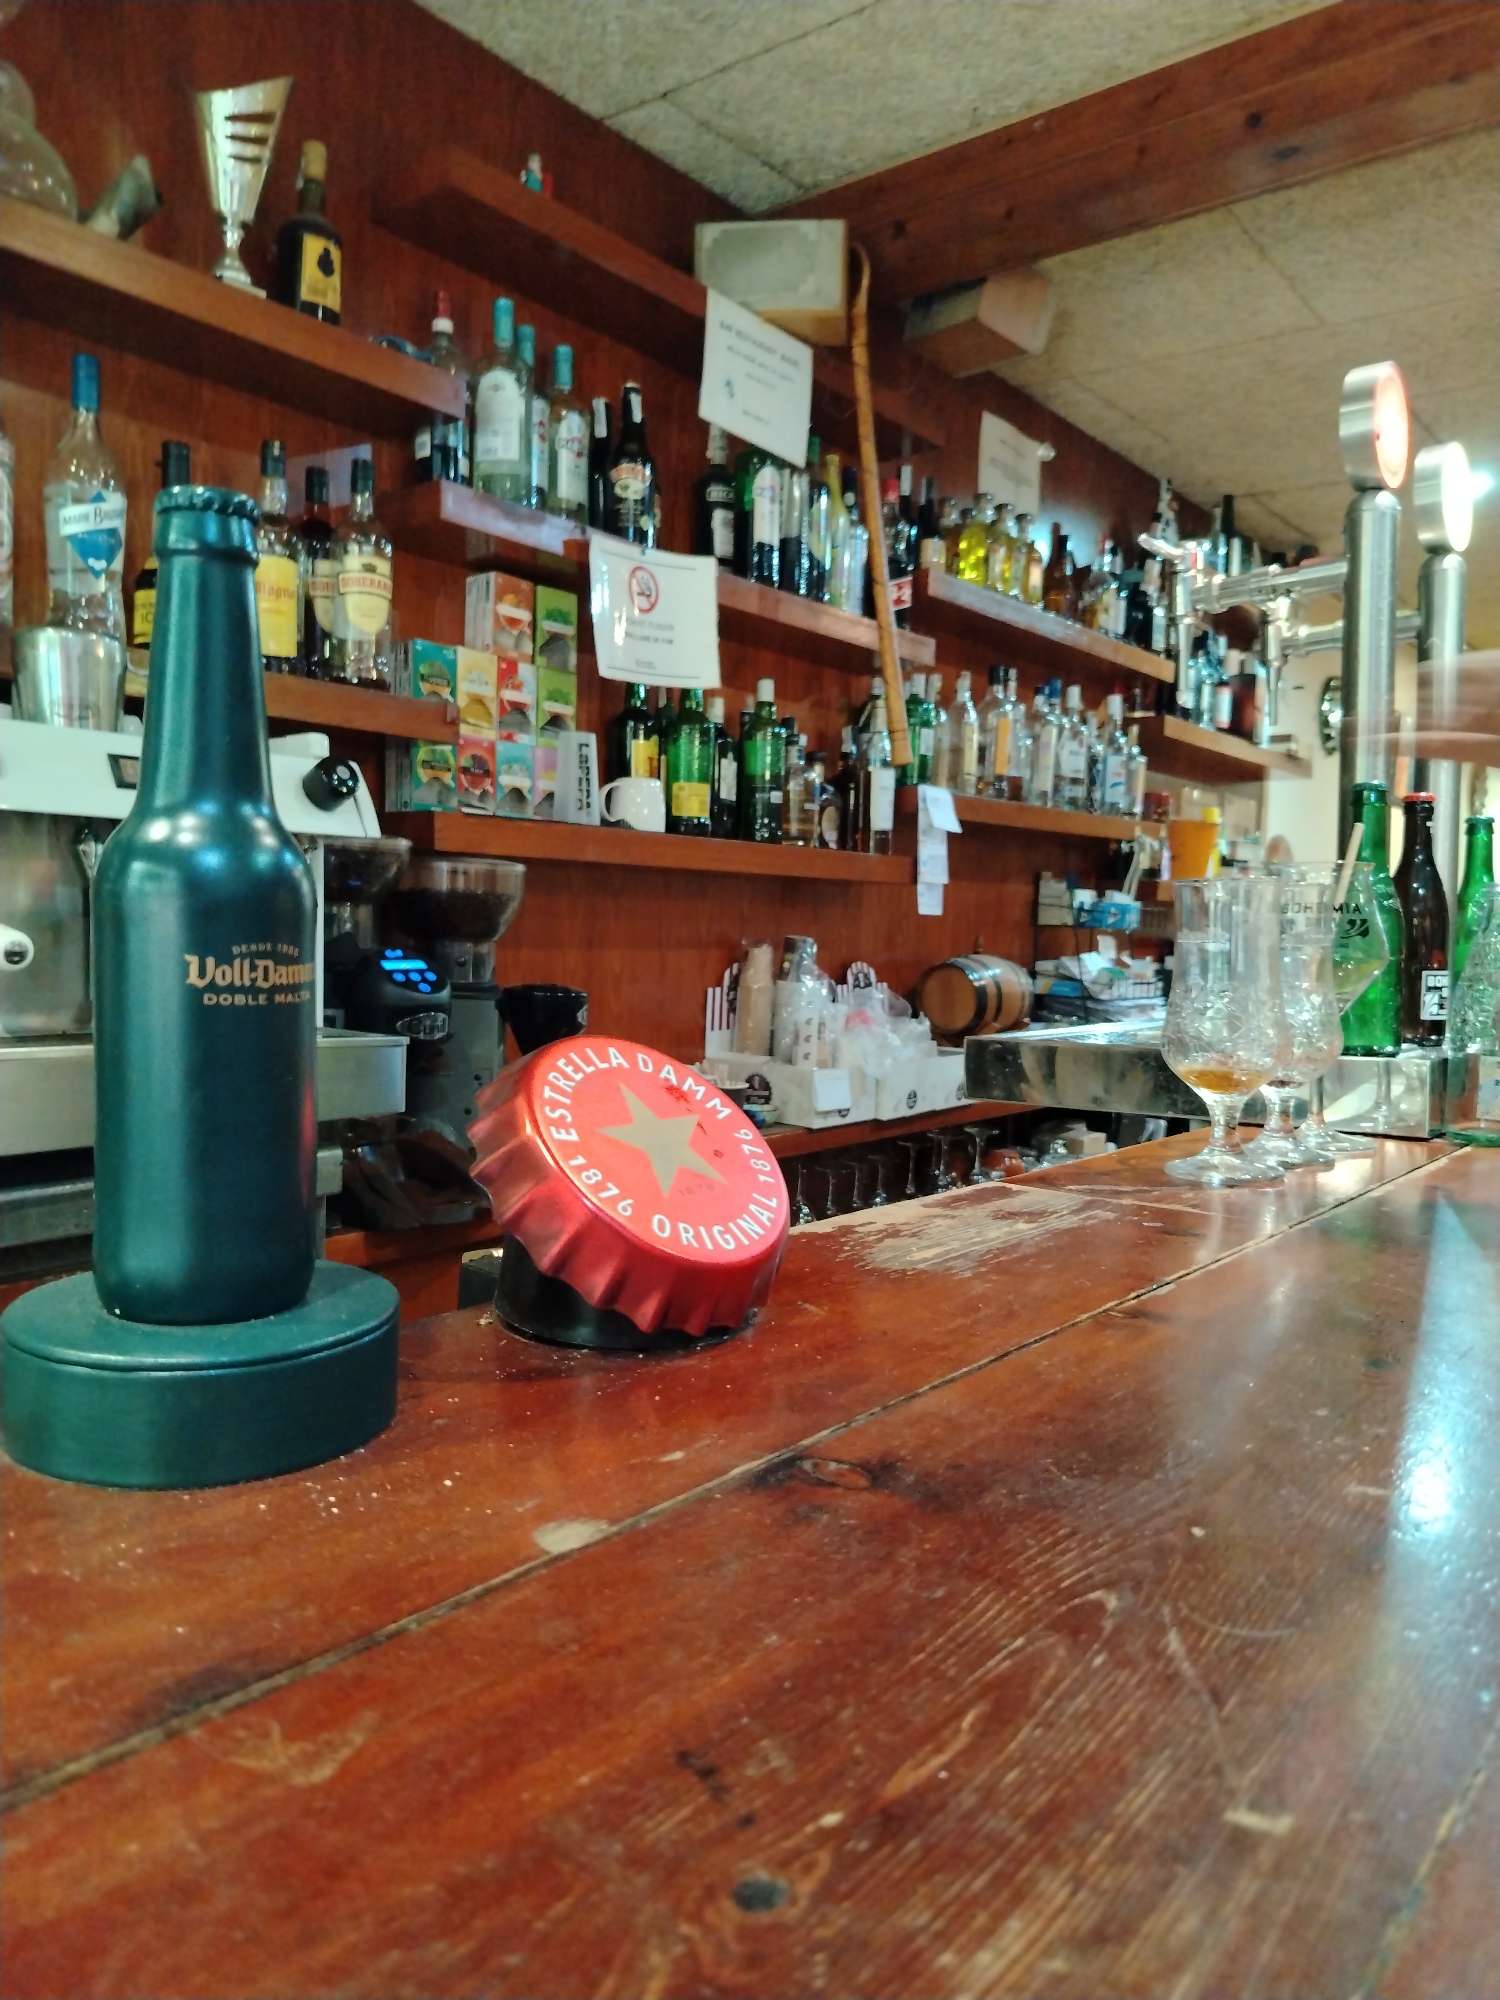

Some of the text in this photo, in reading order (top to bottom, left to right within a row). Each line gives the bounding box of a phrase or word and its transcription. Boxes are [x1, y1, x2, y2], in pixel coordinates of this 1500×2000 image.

[203, 992, 268, 1006] DOBLE
[543, 1046, 733, 1142] ESTRELLA DAMM
[734, 1127, 776, 1184] 1876
[568, 1154, 635, 1217] 1876
[652, 1192, 778, 1251] ORIGINAL
